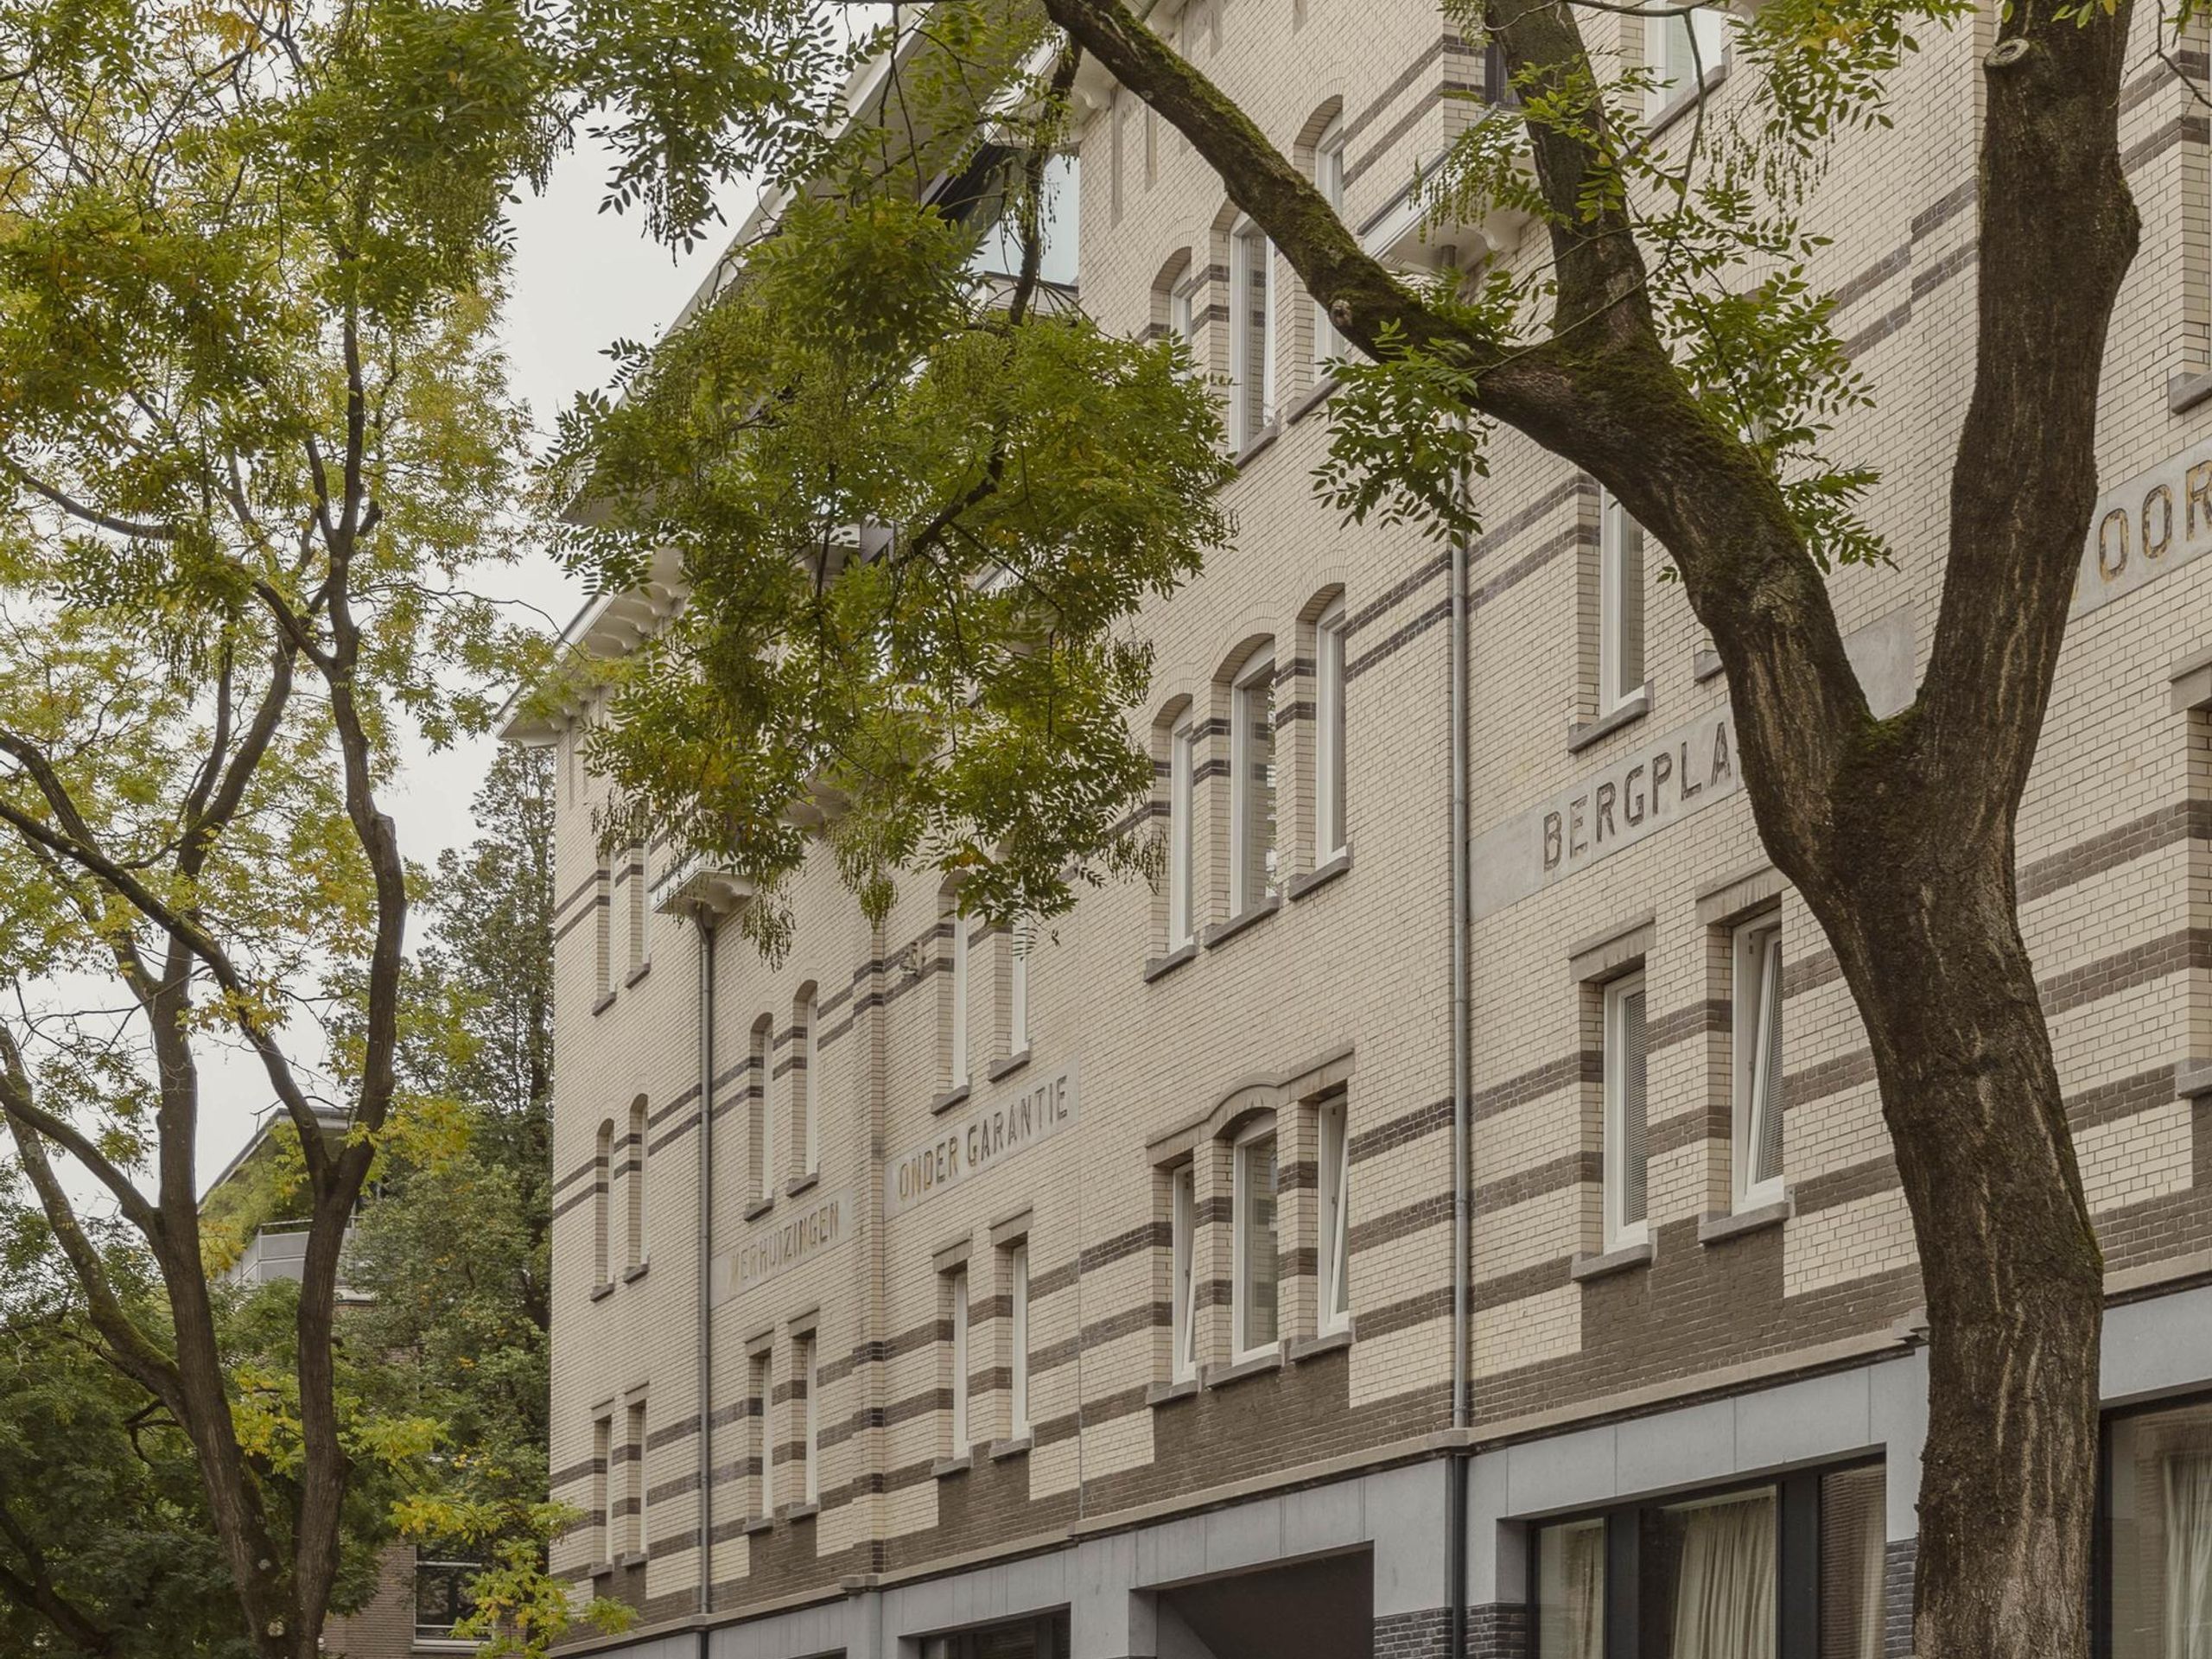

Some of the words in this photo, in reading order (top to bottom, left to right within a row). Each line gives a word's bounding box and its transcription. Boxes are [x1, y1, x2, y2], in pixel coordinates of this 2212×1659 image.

[2074, 460, 2212, 598] OOR
[899, 1136, 959, 1201] ONDER
[967, 1075, 1068, 1167] GARANTIE
